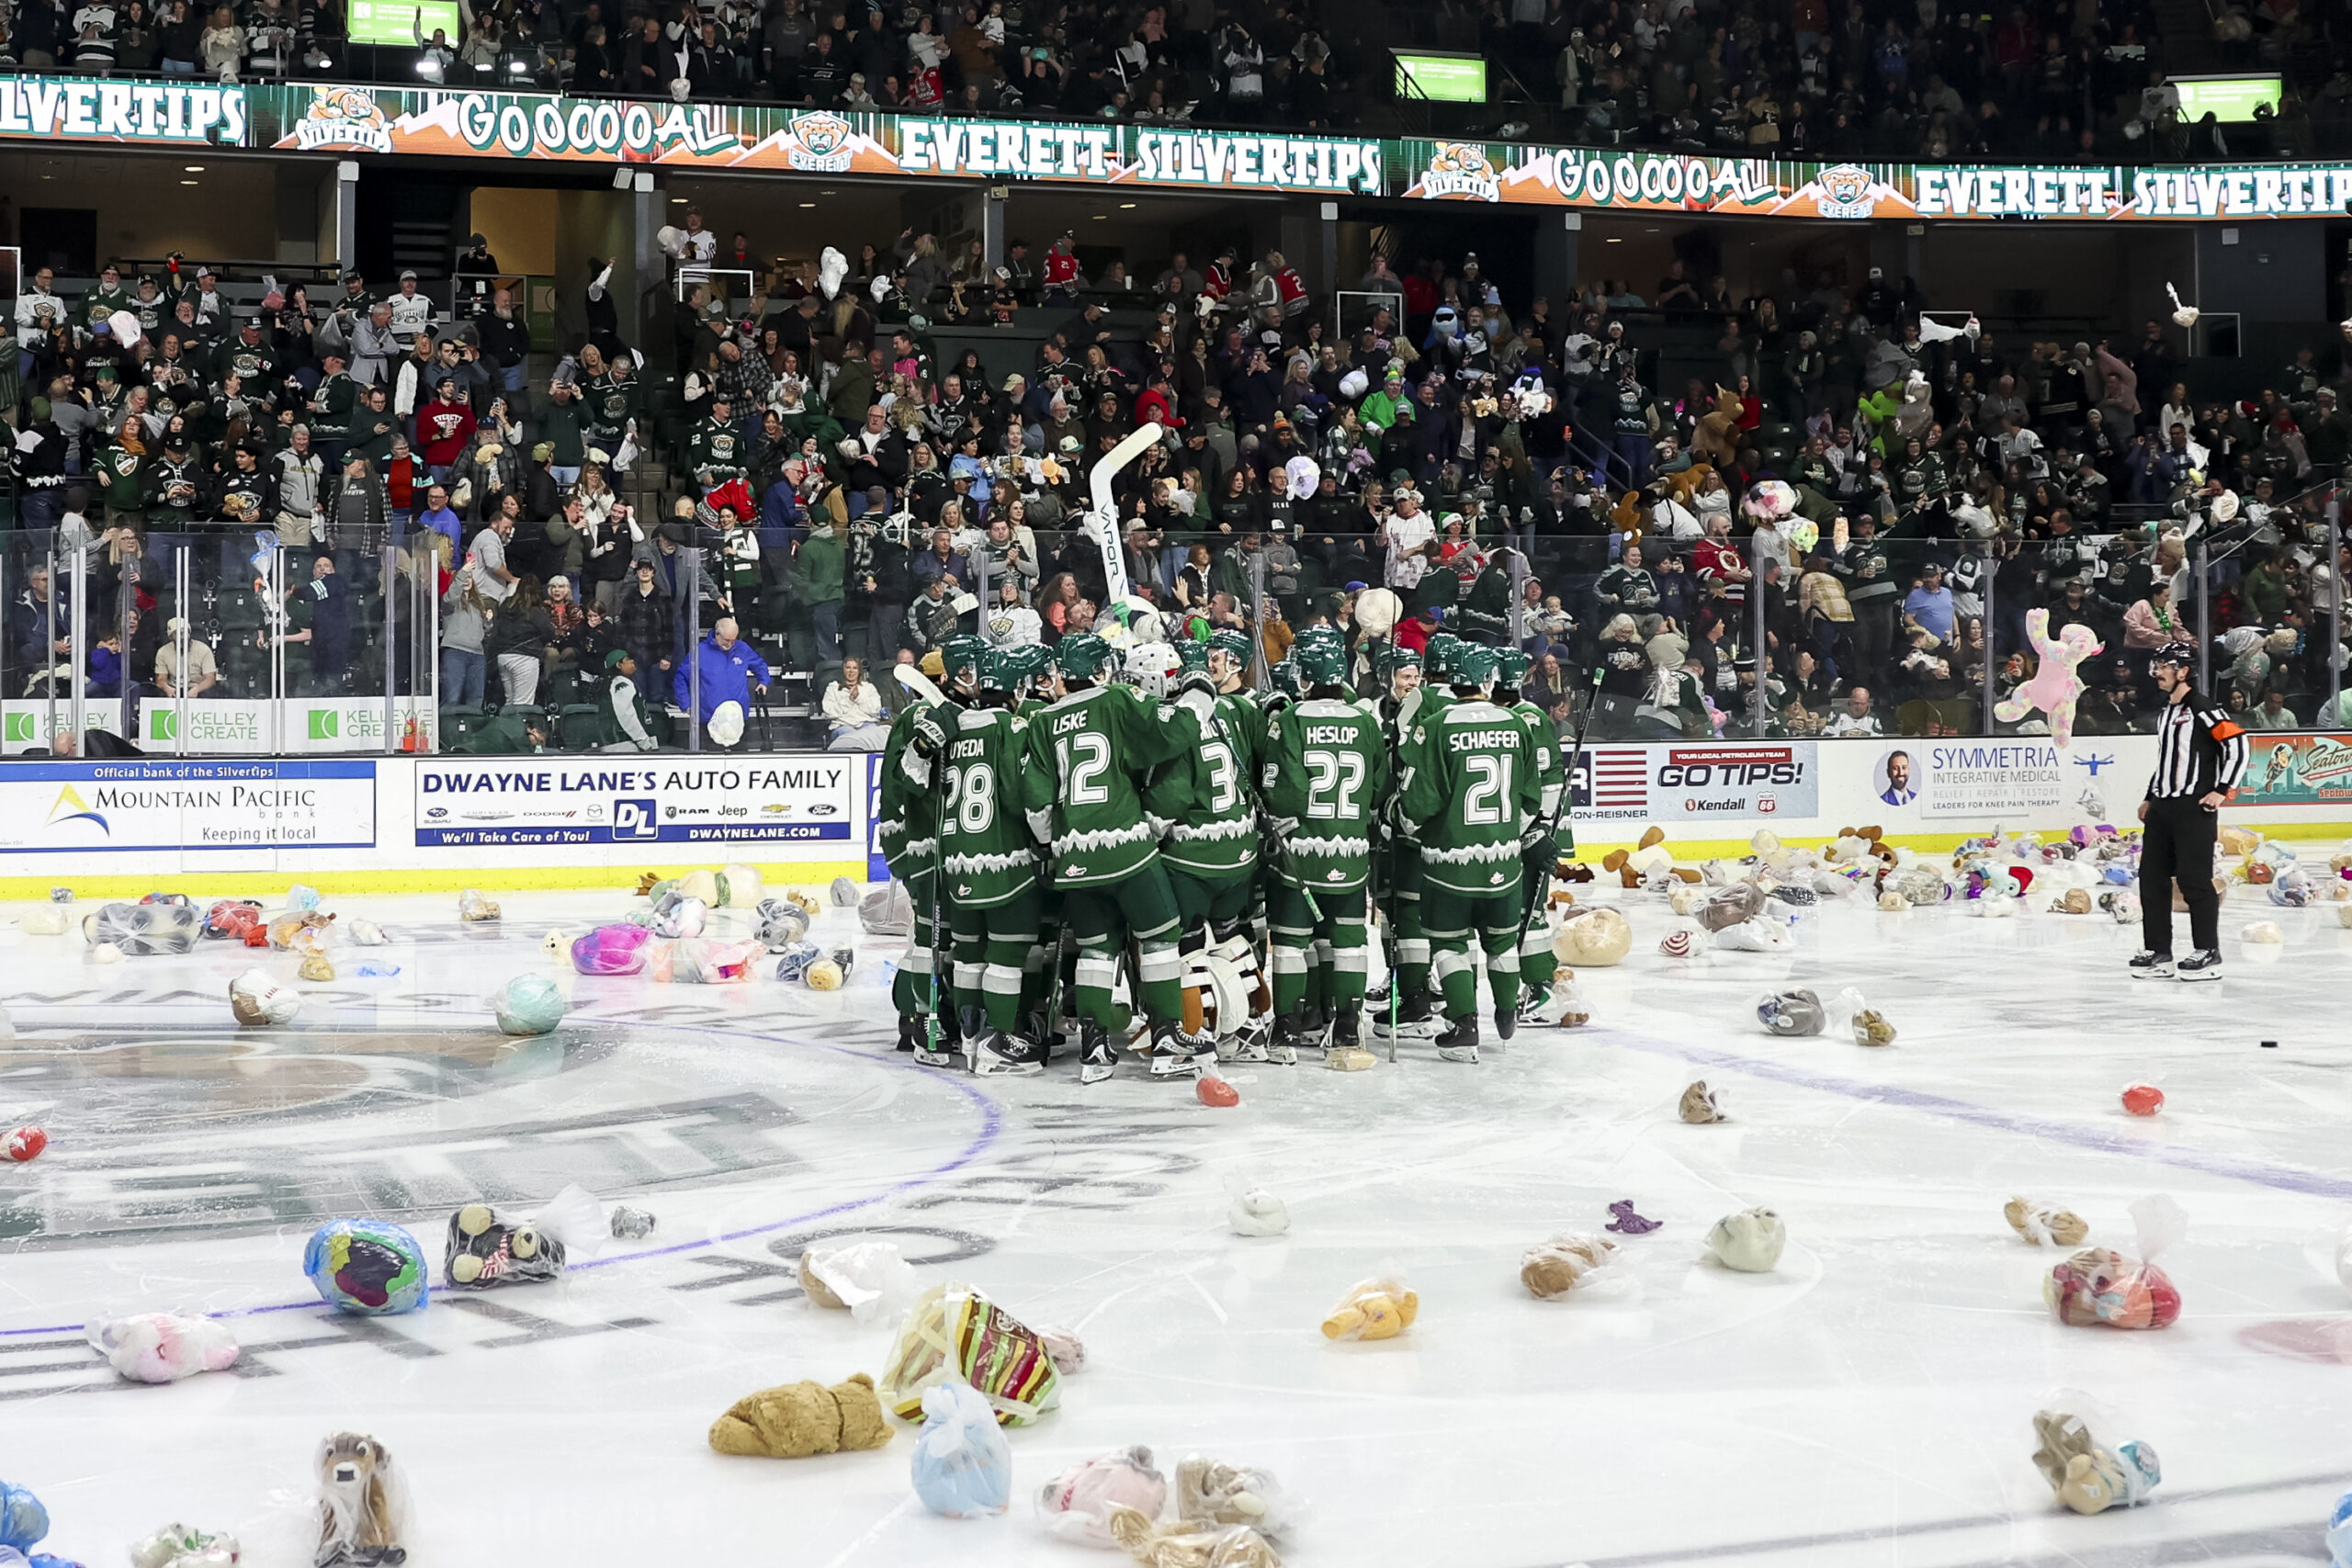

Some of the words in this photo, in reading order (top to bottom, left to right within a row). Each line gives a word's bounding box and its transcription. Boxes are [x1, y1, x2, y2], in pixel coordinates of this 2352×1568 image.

[791, 152, 851, 173] EVERETT
[899, 119, 1108, 176] EVERETT
[1137, 131, 1381, 192] SILVERTIPS
[1916, 169, 2111, 215] EVERETT
[1819, 198, 1874, 219] EVERETT
[1100, 501, 1119, 581] VAPOR
[44, 713, 107, 725] KELEY
[191, 712, 256, 725] KELLEY
[1053, 710, 1088, 735] LISKE
[191, 726, 258, 739] CREATE
[1306, 726, 1360, 745] HESLOP
[1449, 730, 1521, 753] SCHAEFER
[1932, 746, 2059, 770] SYMMETRIA
[94, 767, 139, 778] Official
[143, 767, 173, 778] bank
[176, 766, 190, 778] of
[193, 766, 213, 777] the
[217, 766, 274, 778] Silvertips
[1055, 731, 1112, 807] 12
[1199, 741, 1238, 814] 3
[1657, 764, 1712, 787] GO
[1717, 762, 1804, 786] TIPS!
[1933, 771, 2007, 784] INTEGRATIVE
[2009, 770, 2061, 783] MEDICAL
[423, 773, 552, 794] DWAYNE
[663, 770, 741, 791] AUTO
[748, 769, 842, 790] FAMILY
[1303, 750, 1366, 819] 22
[1464, 753, 1513, 826] 21
[942, 761, 996, 835] 28
[1933, 789, 1964, 799] RELIEF
[1976, 788, 2008, 797] REPAIR
[2020, 787, 2060, 796] RESTORE
[259, 808, 315, 819] bank
[717, 806, 749, 818] Jeep
[811, 805, 833, 816] Ford
[1570, 809, 1648, 819] ON-REISNER
[1697, 798, 1746, 811] Kendall
[1758, 800, 1773, 811] 66
[202, 827, 261, 843] Keeping
[266, 826, 277, 840] it
[283, 825, 316, 839] local
[441, 830, 475, 844] We'll
[479, 829, 507, 843] Take
[511, 829, 543, 843] Care
[545, 829, 560, 842] of
[563, 829, 591, 842] You!
[688, 827, 821, 840] DWAYNELANE.COM
